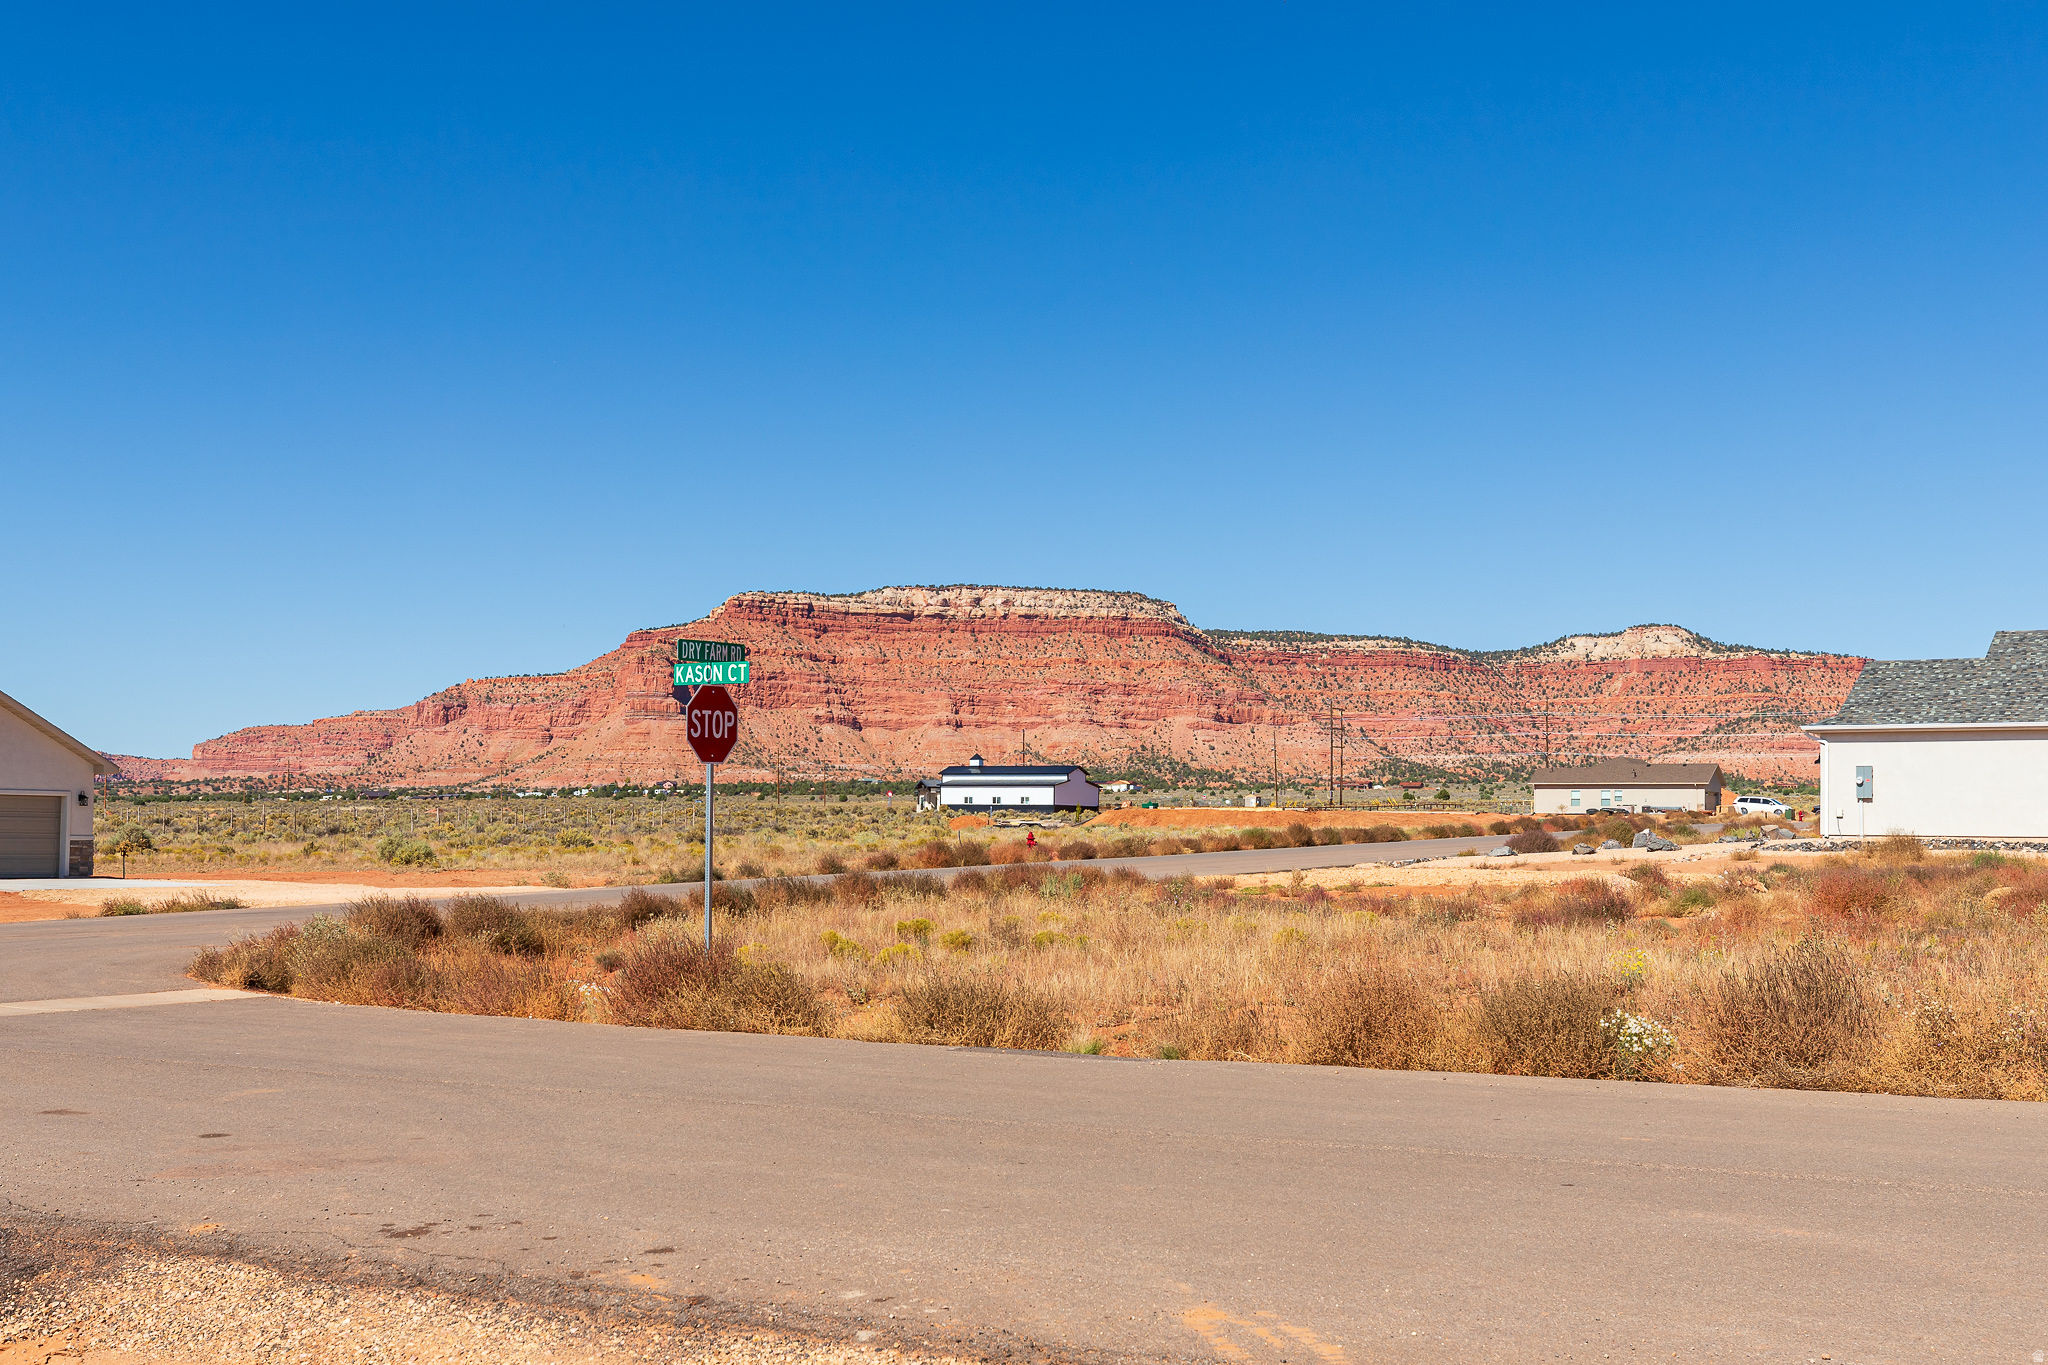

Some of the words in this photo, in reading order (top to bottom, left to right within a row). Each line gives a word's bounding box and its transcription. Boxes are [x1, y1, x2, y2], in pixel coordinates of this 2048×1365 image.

[682, 641, 702, 660] DRY
[704, 643, 728, 662] FARM
[730, 646, 742, 662] RD
[675, 665, 723, 683] KASON
[727, 663, 747, 682] CT
[690, 709, 735, 739] STOP
